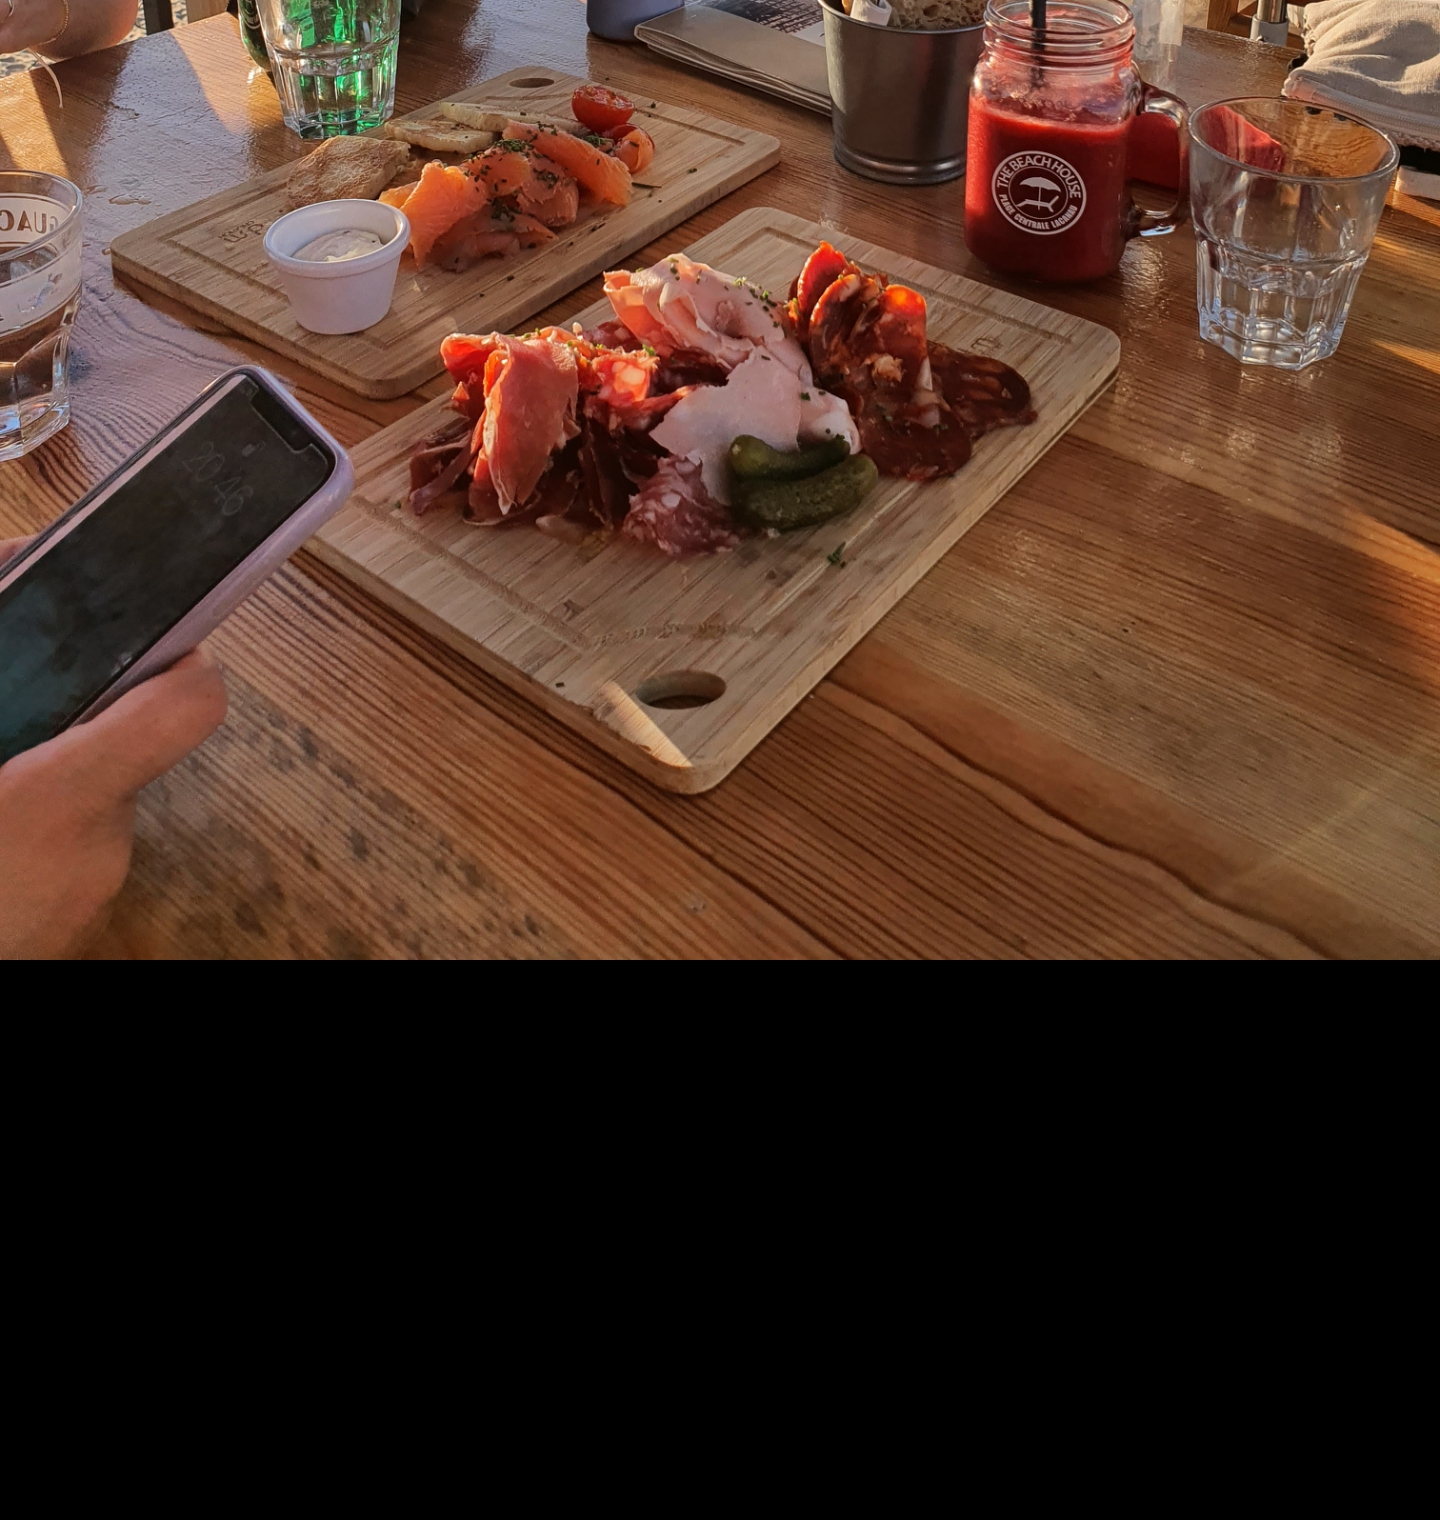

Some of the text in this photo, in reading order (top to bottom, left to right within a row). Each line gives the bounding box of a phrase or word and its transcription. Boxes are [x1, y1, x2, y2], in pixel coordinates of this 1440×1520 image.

[997, 155, 1081, 198] THE BEACH HOUSE
[999, 194, 1078, 230] PLAGE CENTRALE LACANAU
